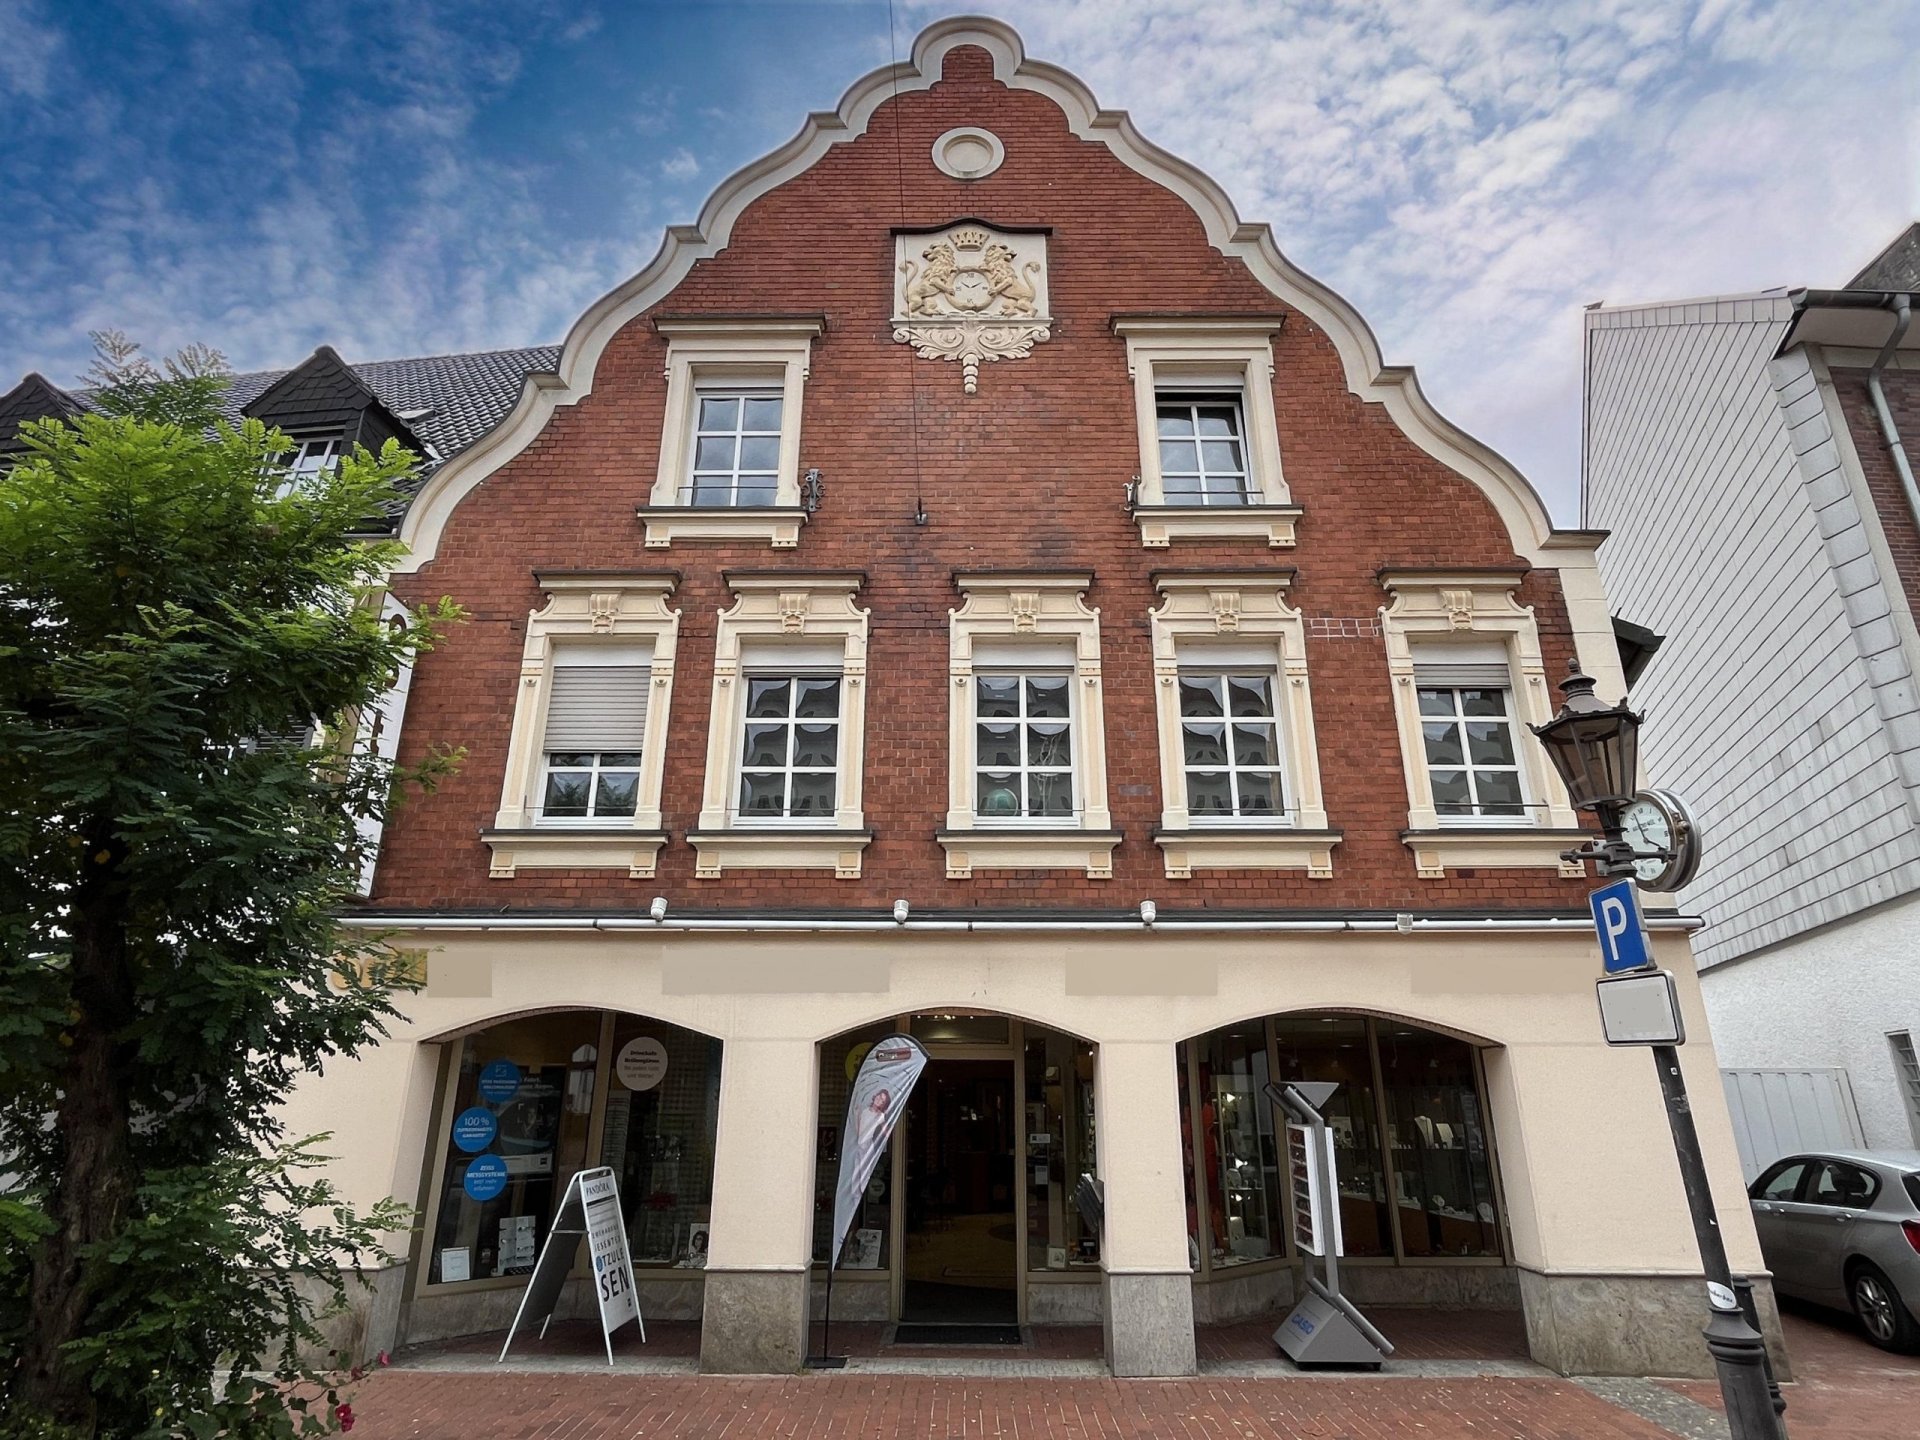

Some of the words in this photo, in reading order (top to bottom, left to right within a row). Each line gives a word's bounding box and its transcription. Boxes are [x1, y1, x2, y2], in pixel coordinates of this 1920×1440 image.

[1600, 897, 1627, 961] P
[464, 1117, 480, 1127] 100
[601, 1264, 630, 1302] SEN
[1291, 1313, 1315, 1335] CASIO
